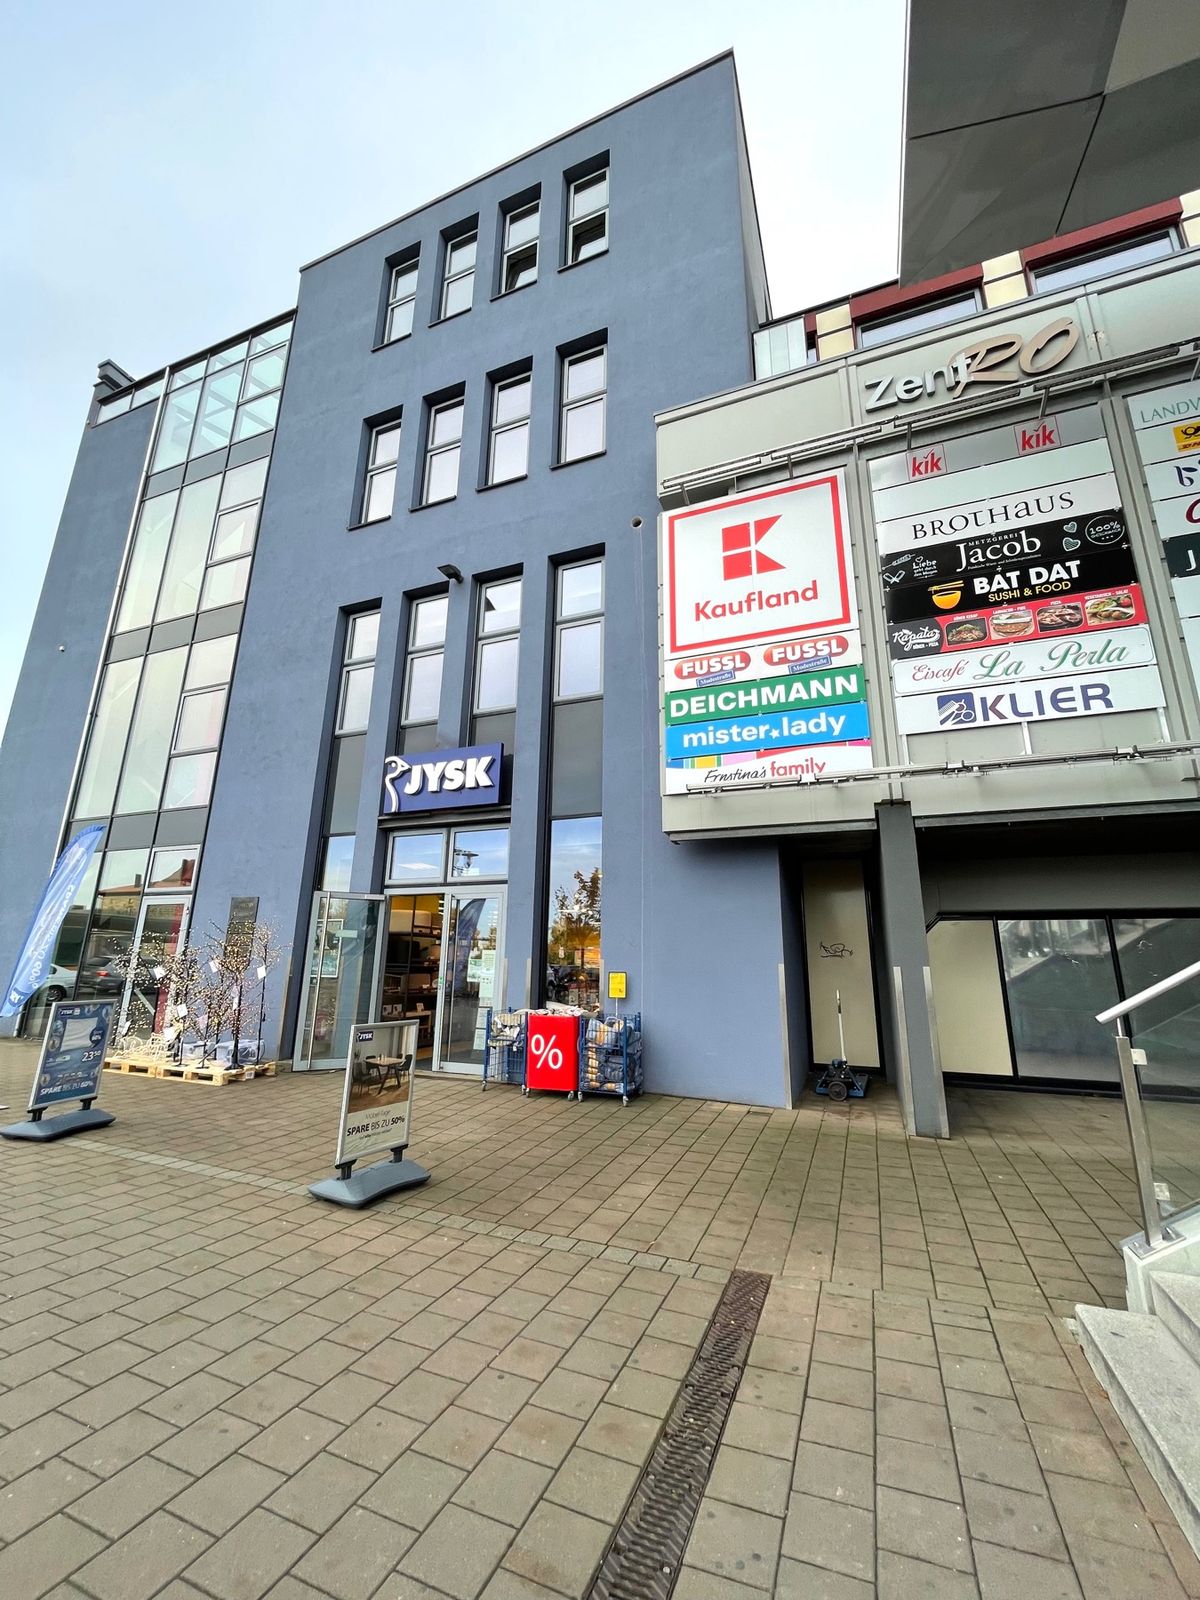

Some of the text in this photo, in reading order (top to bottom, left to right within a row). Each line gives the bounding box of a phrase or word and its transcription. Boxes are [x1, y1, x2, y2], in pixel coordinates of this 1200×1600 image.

[955, 529, 1042, 572] Jacob
[968, 532, 1018, 547] METZGEREI
[972, 570, 1021, 595] BAT
[1028, 560, 1081, 586] DAT
[988, 581, 1072, 603] SUSHI & FOOD
[694, 579, 819, 622] Kaufland
[682, 654, 746, 677] FUSSL
[772, 638, 843, 663] FUSSL
[912, 638, 1128, 682] Eiscafé La Perla
[670, 674, 858, 718] DEICHMANN
[980, 682, 1114, 722] KLIER
[403, 755, 494, 795] JYSK
[770, 757, 826, 777] family
[346, 1122, 371, 1137] SPARE
[380, 1118, 391, 1128] ZU
[390, 1115, 406, 1126] 50%
